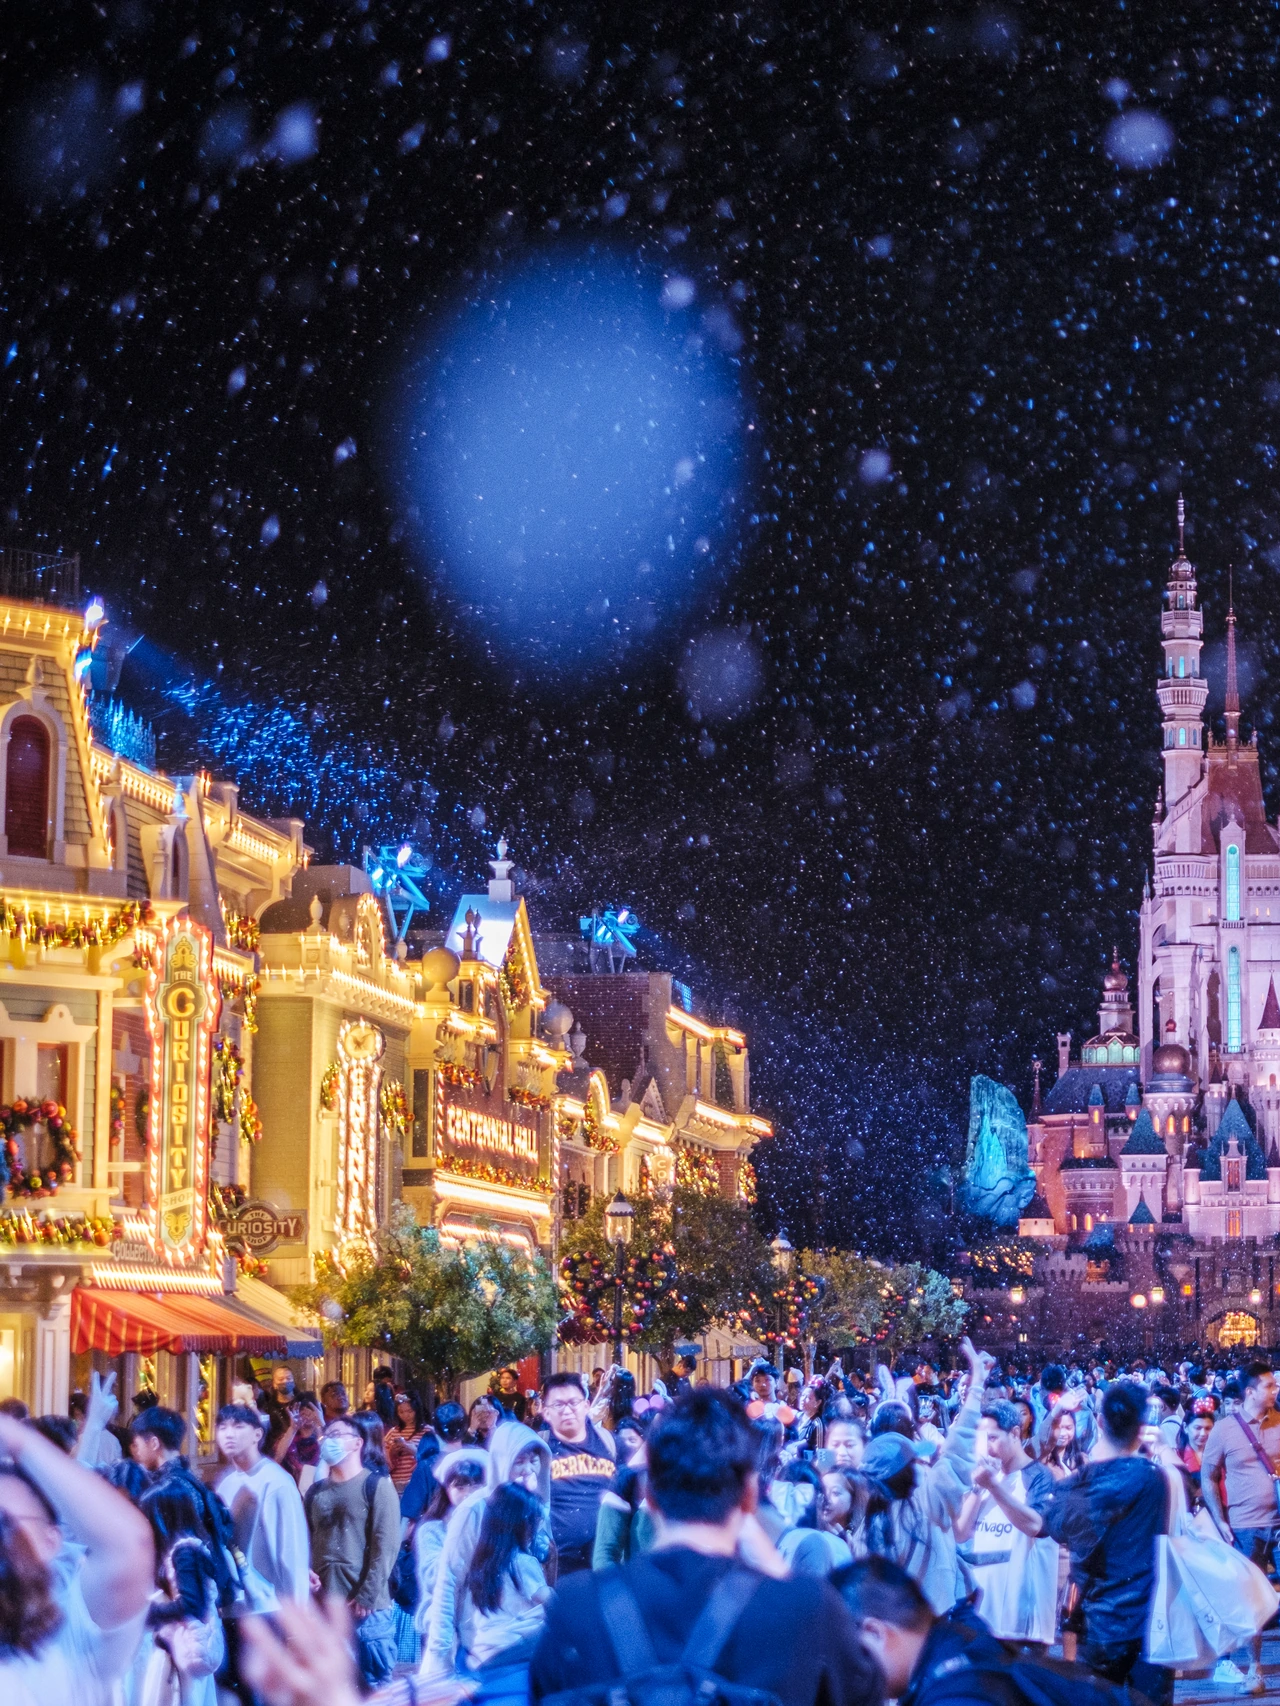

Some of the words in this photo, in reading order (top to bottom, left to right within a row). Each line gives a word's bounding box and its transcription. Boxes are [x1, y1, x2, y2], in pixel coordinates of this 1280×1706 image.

[174, 971, 193, 981] THE
[168, 987, 196, 1189] CURIOSITY
[514, 1123, 538, 1162] HALL
[656, 1159, 668, 1179] CO
[162, 1191, 194, 1208] SHOP
[250, 1210, 267, 1218] THE
[975, 1517, 1013, 1538] rivago
